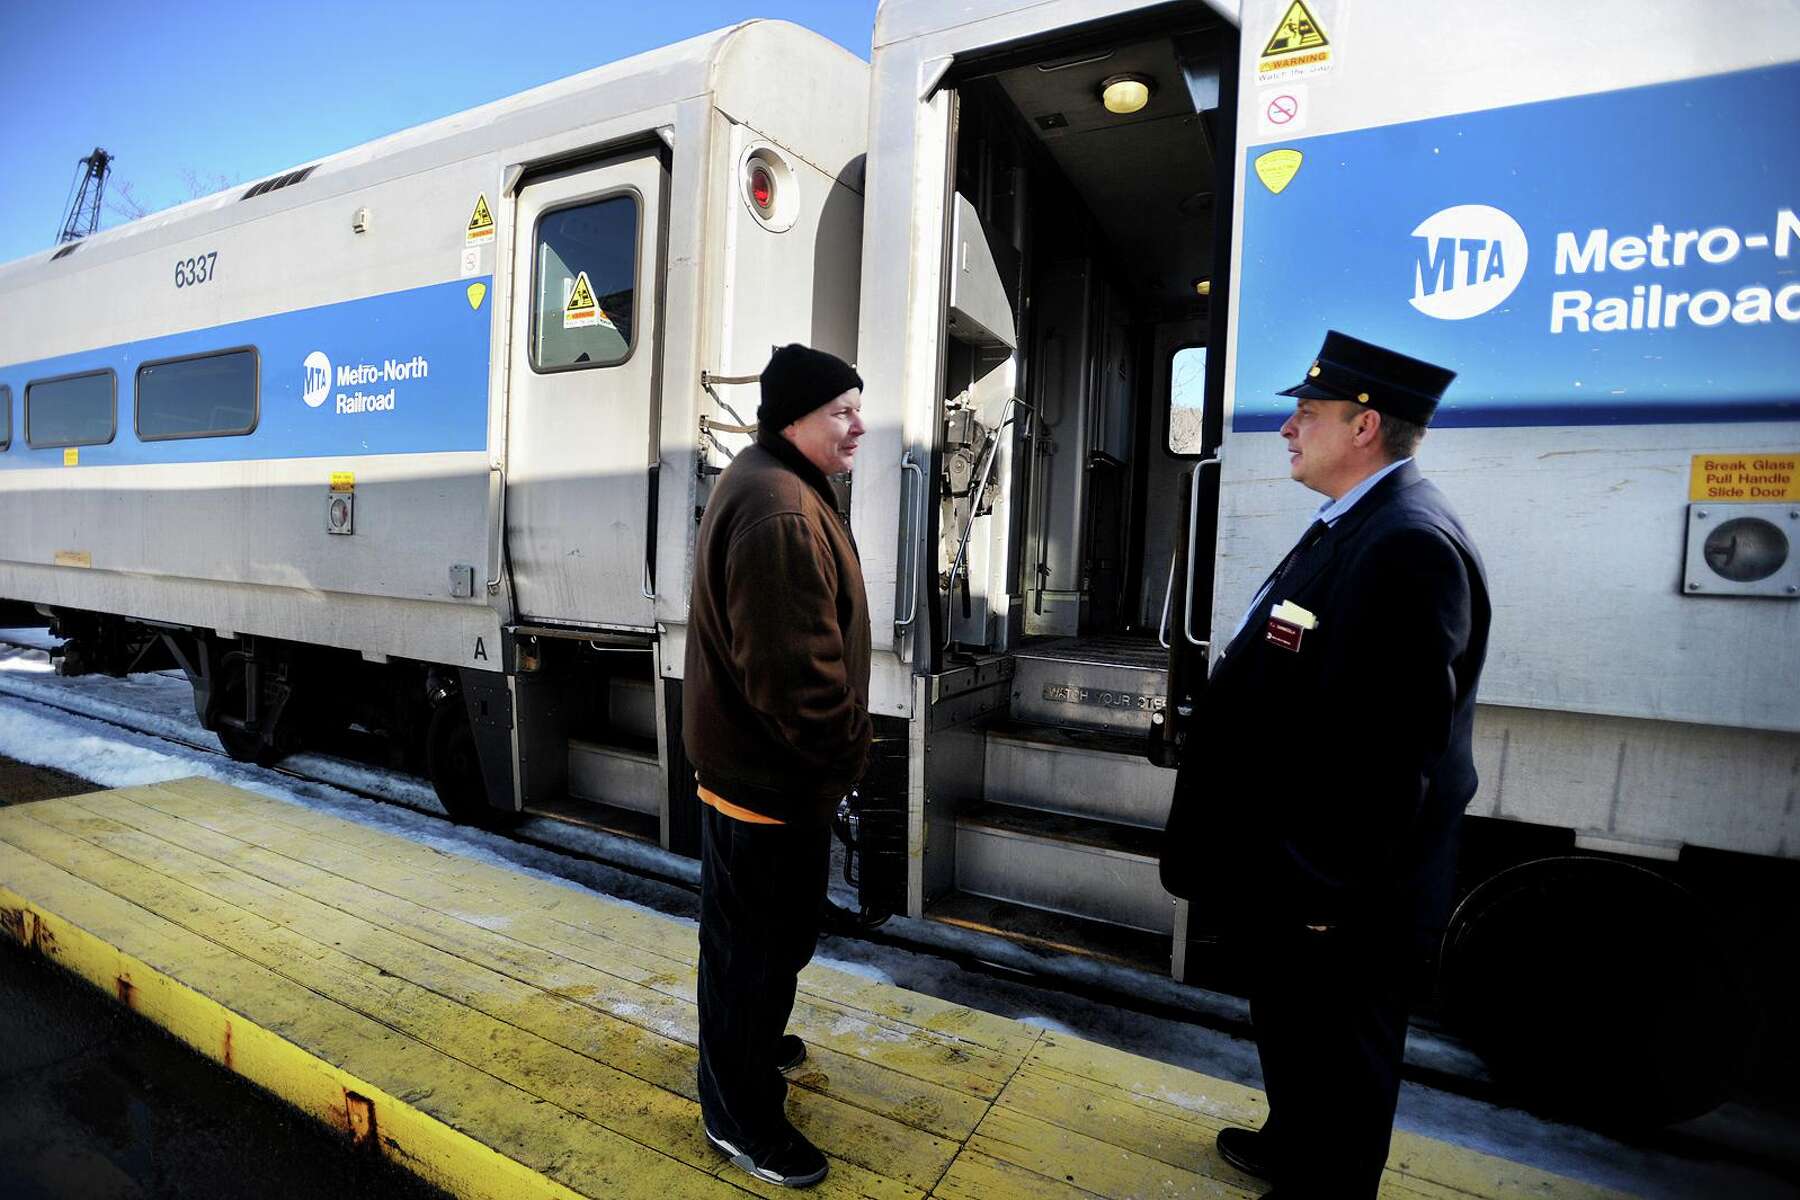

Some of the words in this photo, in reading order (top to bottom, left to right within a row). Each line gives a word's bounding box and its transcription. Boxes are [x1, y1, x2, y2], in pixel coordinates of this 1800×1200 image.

[1272, 52, 1328, 69] WARNING
[175, 251, 218, 288] 6337
[1408, 236, 1506, 300] MTA
[304, 366, 327, 395] MTA
[337, 355, 429, 387] Metro-North
[336, 389, 395, 414] Railroad
[1704, 460, 1746, 472] Break
[1753, 460, 1795, 471] Glass
[1706, 473, 1733, 485] Pull
[1738, 473, 1791, 485] Handle
[1708, 487, 1745, 498] Slide
[1750, 487, 1788, 498] Door
[474, 637, 488, 661] A
[1049, 686, 1089, 701] WATCH
